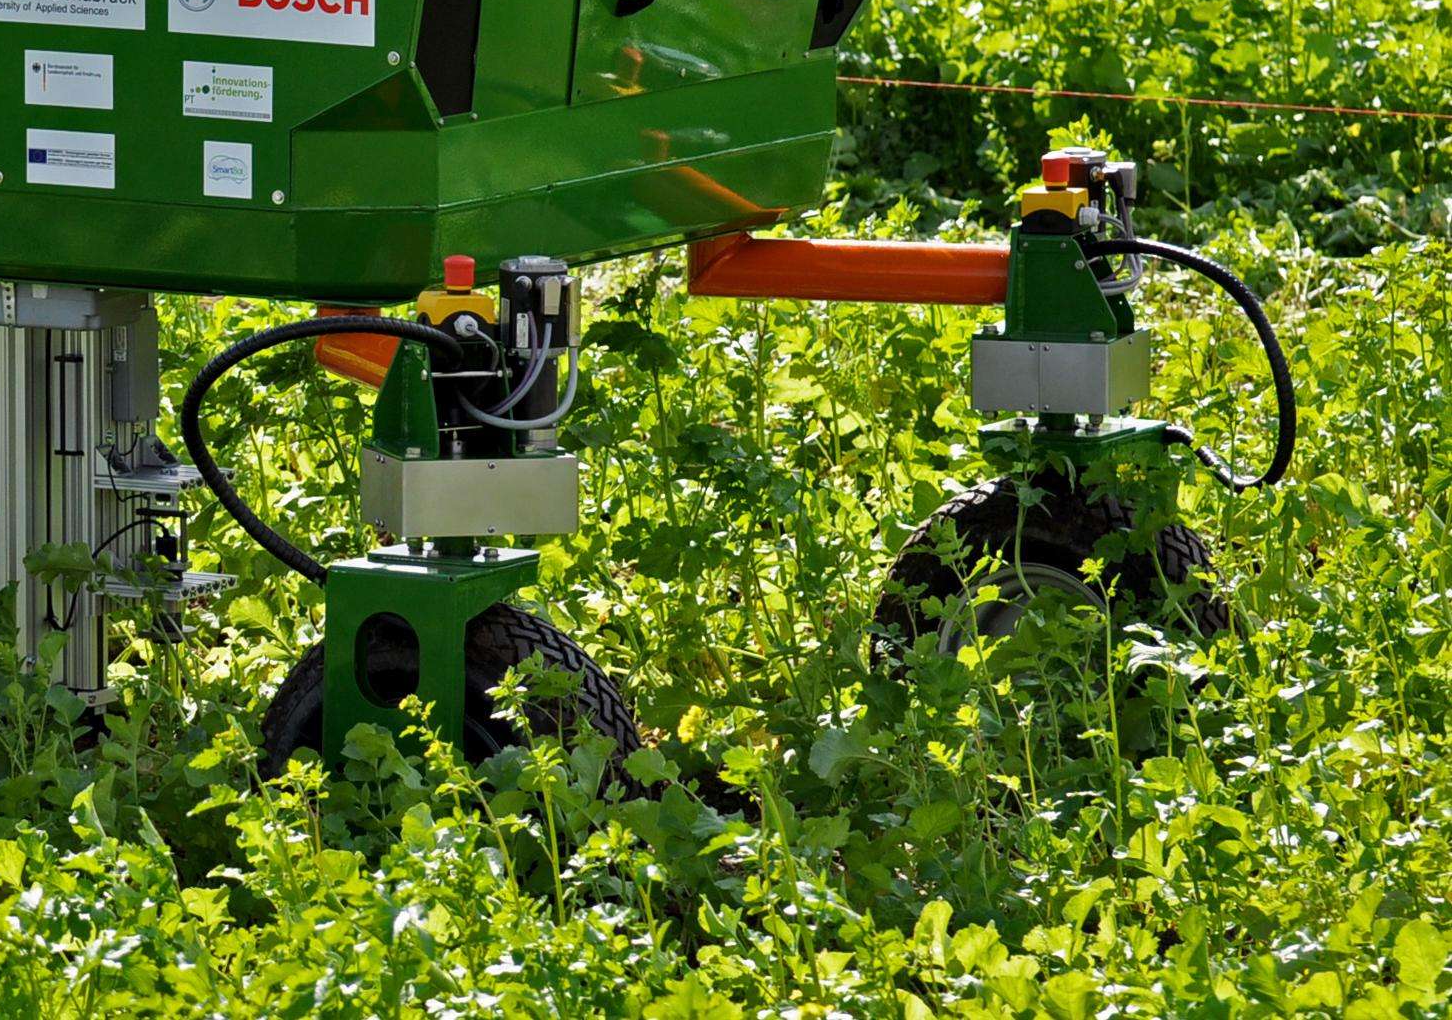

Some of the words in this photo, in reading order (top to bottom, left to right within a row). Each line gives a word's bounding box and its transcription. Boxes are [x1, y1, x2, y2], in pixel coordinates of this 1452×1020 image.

[23, 1, 32, 11] of
[35, 2, 68, 15] Applied
[69, 5, 109, 16] Sciences
